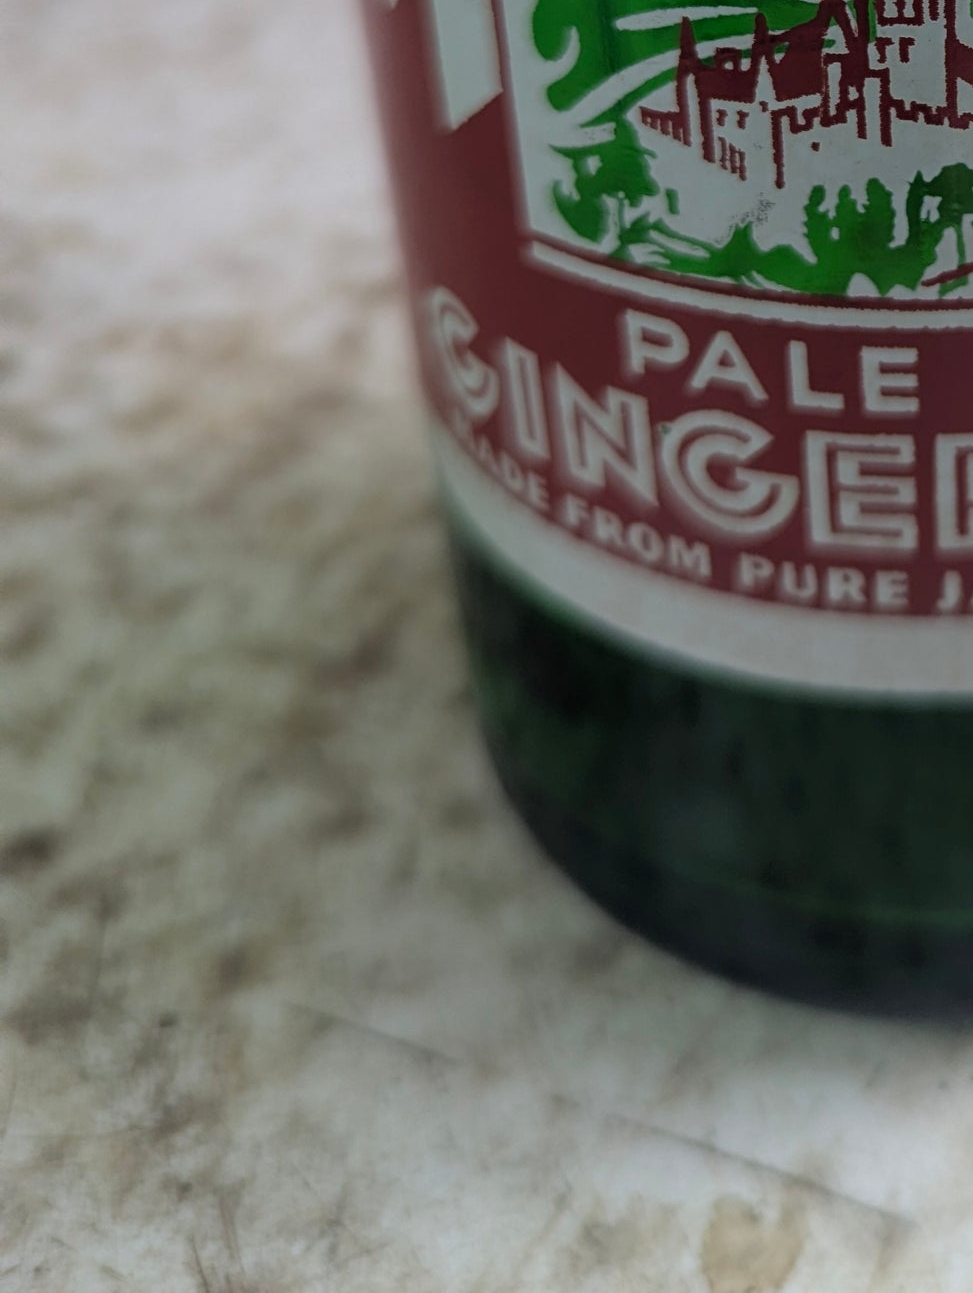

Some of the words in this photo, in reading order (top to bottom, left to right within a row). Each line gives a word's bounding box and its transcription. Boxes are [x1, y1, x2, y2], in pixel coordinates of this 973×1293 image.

[623, 307, 920, 413] PALE
[561, 491, 712, 577] FROM
[738, 553, 909, 606] PURE
